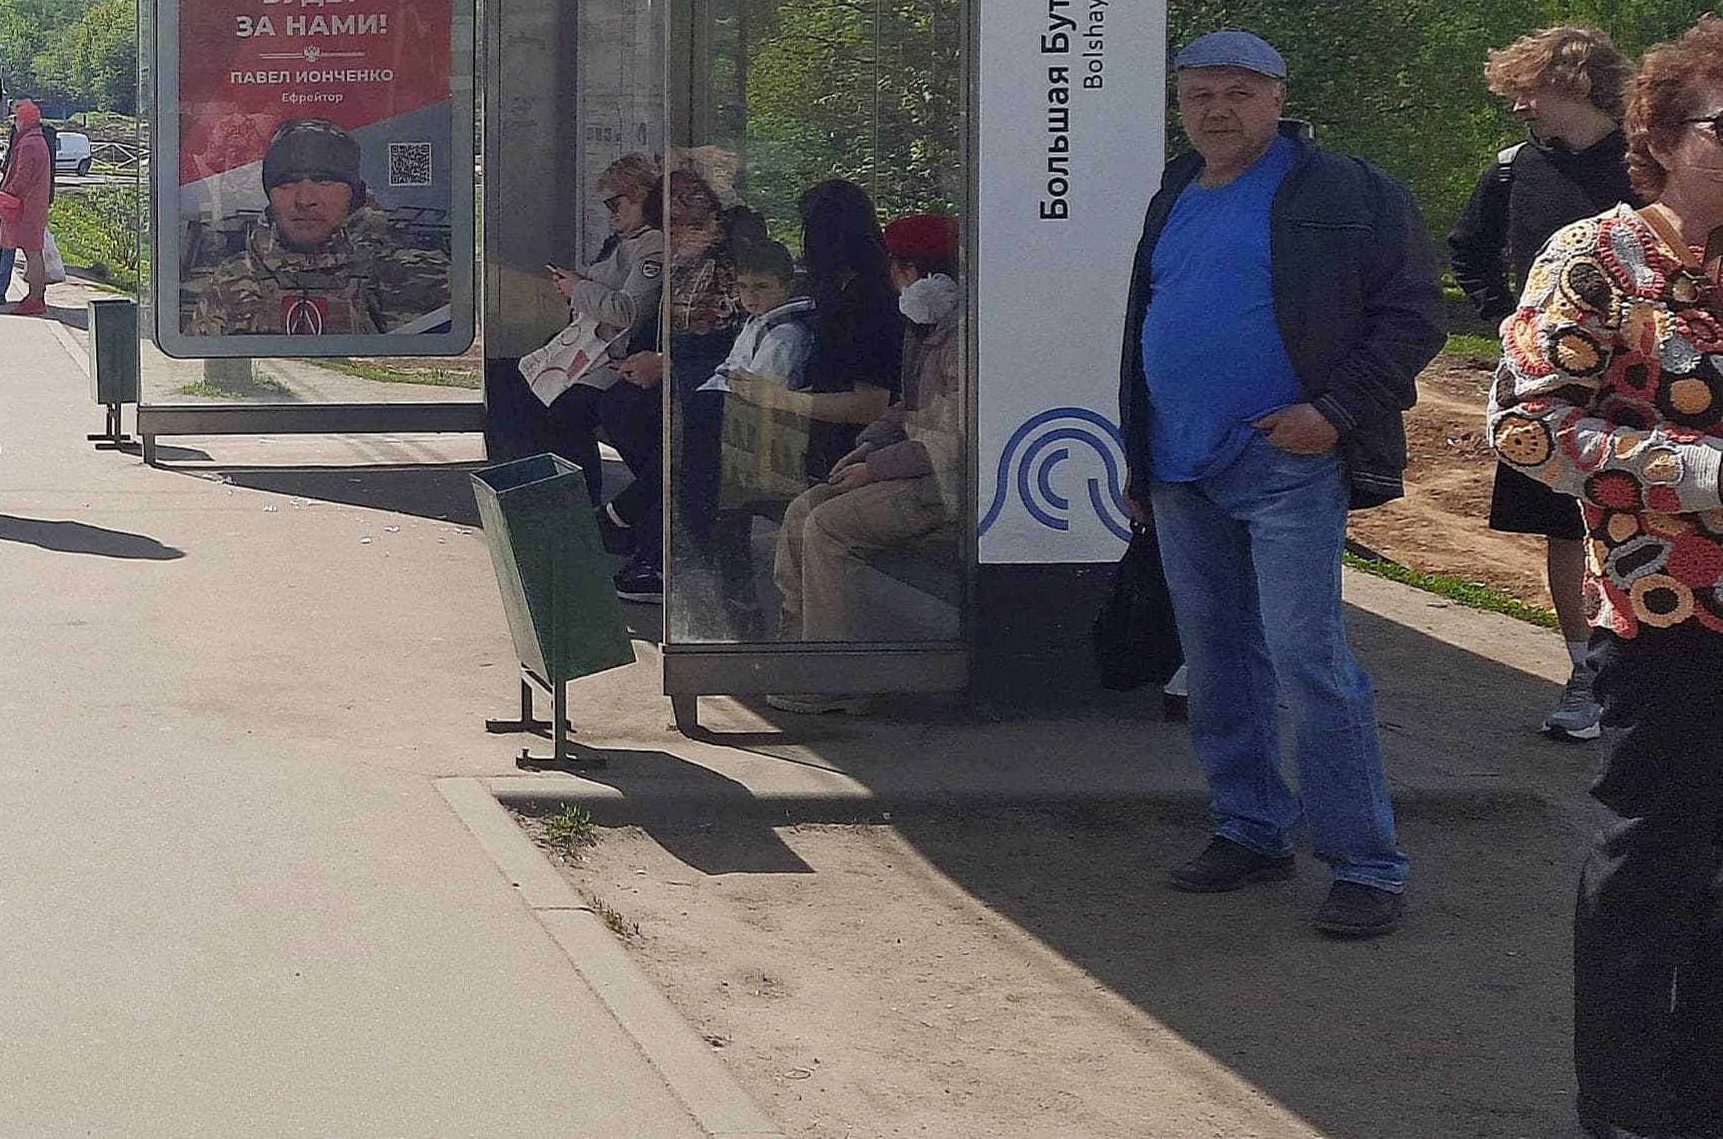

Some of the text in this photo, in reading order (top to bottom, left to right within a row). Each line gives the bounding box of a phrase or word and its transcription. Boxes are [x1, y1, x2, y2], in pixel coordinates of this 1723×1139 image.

[236, 14, 389, 38] ЗА НАМИ!
[230, 69, 395, 85] ПАВЕЛ ИОНЧЕНКО
[282, 91, 344, 105] Ефрейтор
[1039, 66, 1070, 221] Большая
